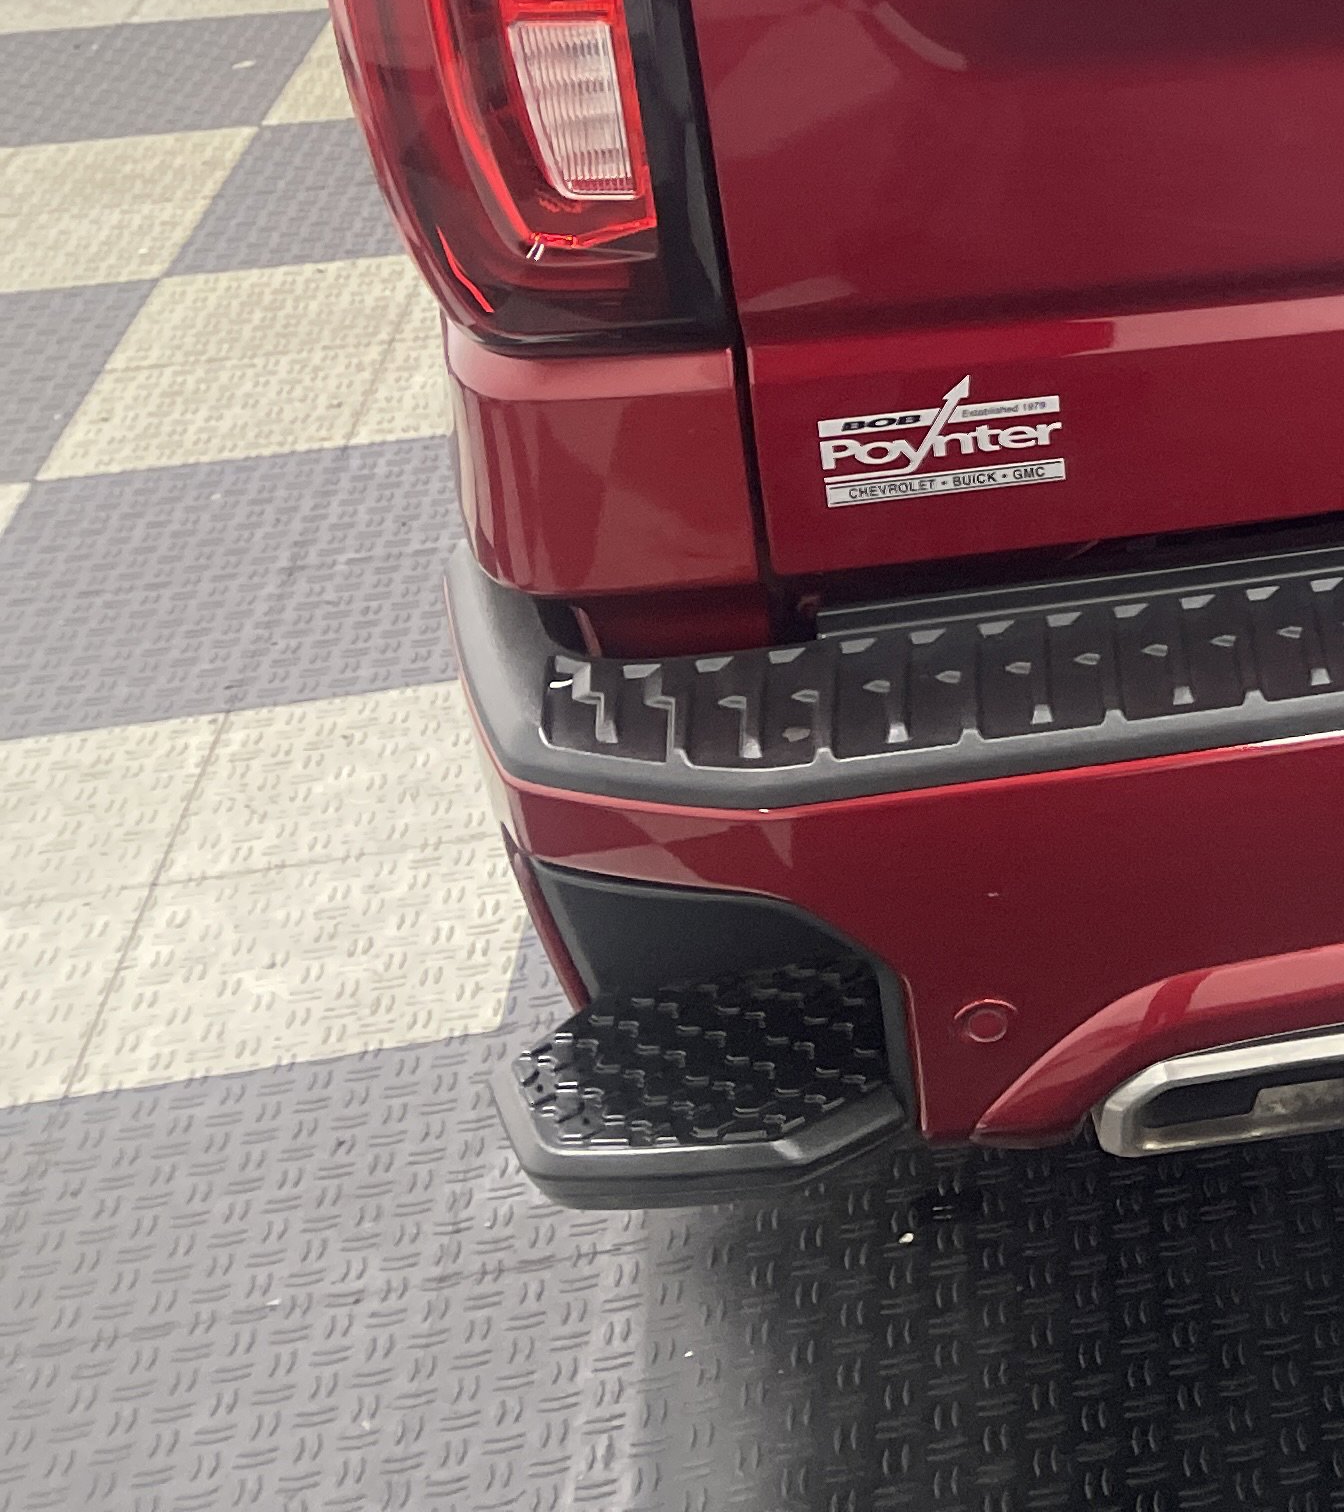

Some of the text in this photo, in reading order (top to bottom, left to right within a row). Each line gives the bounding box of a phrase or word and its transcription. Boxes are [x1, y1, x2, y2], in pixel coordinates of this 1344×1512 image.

[841, 414, 921, 432] BOB
[819, 420, 1062, 476] Poynter
[848, 466, 1046, 499] CHEVROLET BUICK GMC
